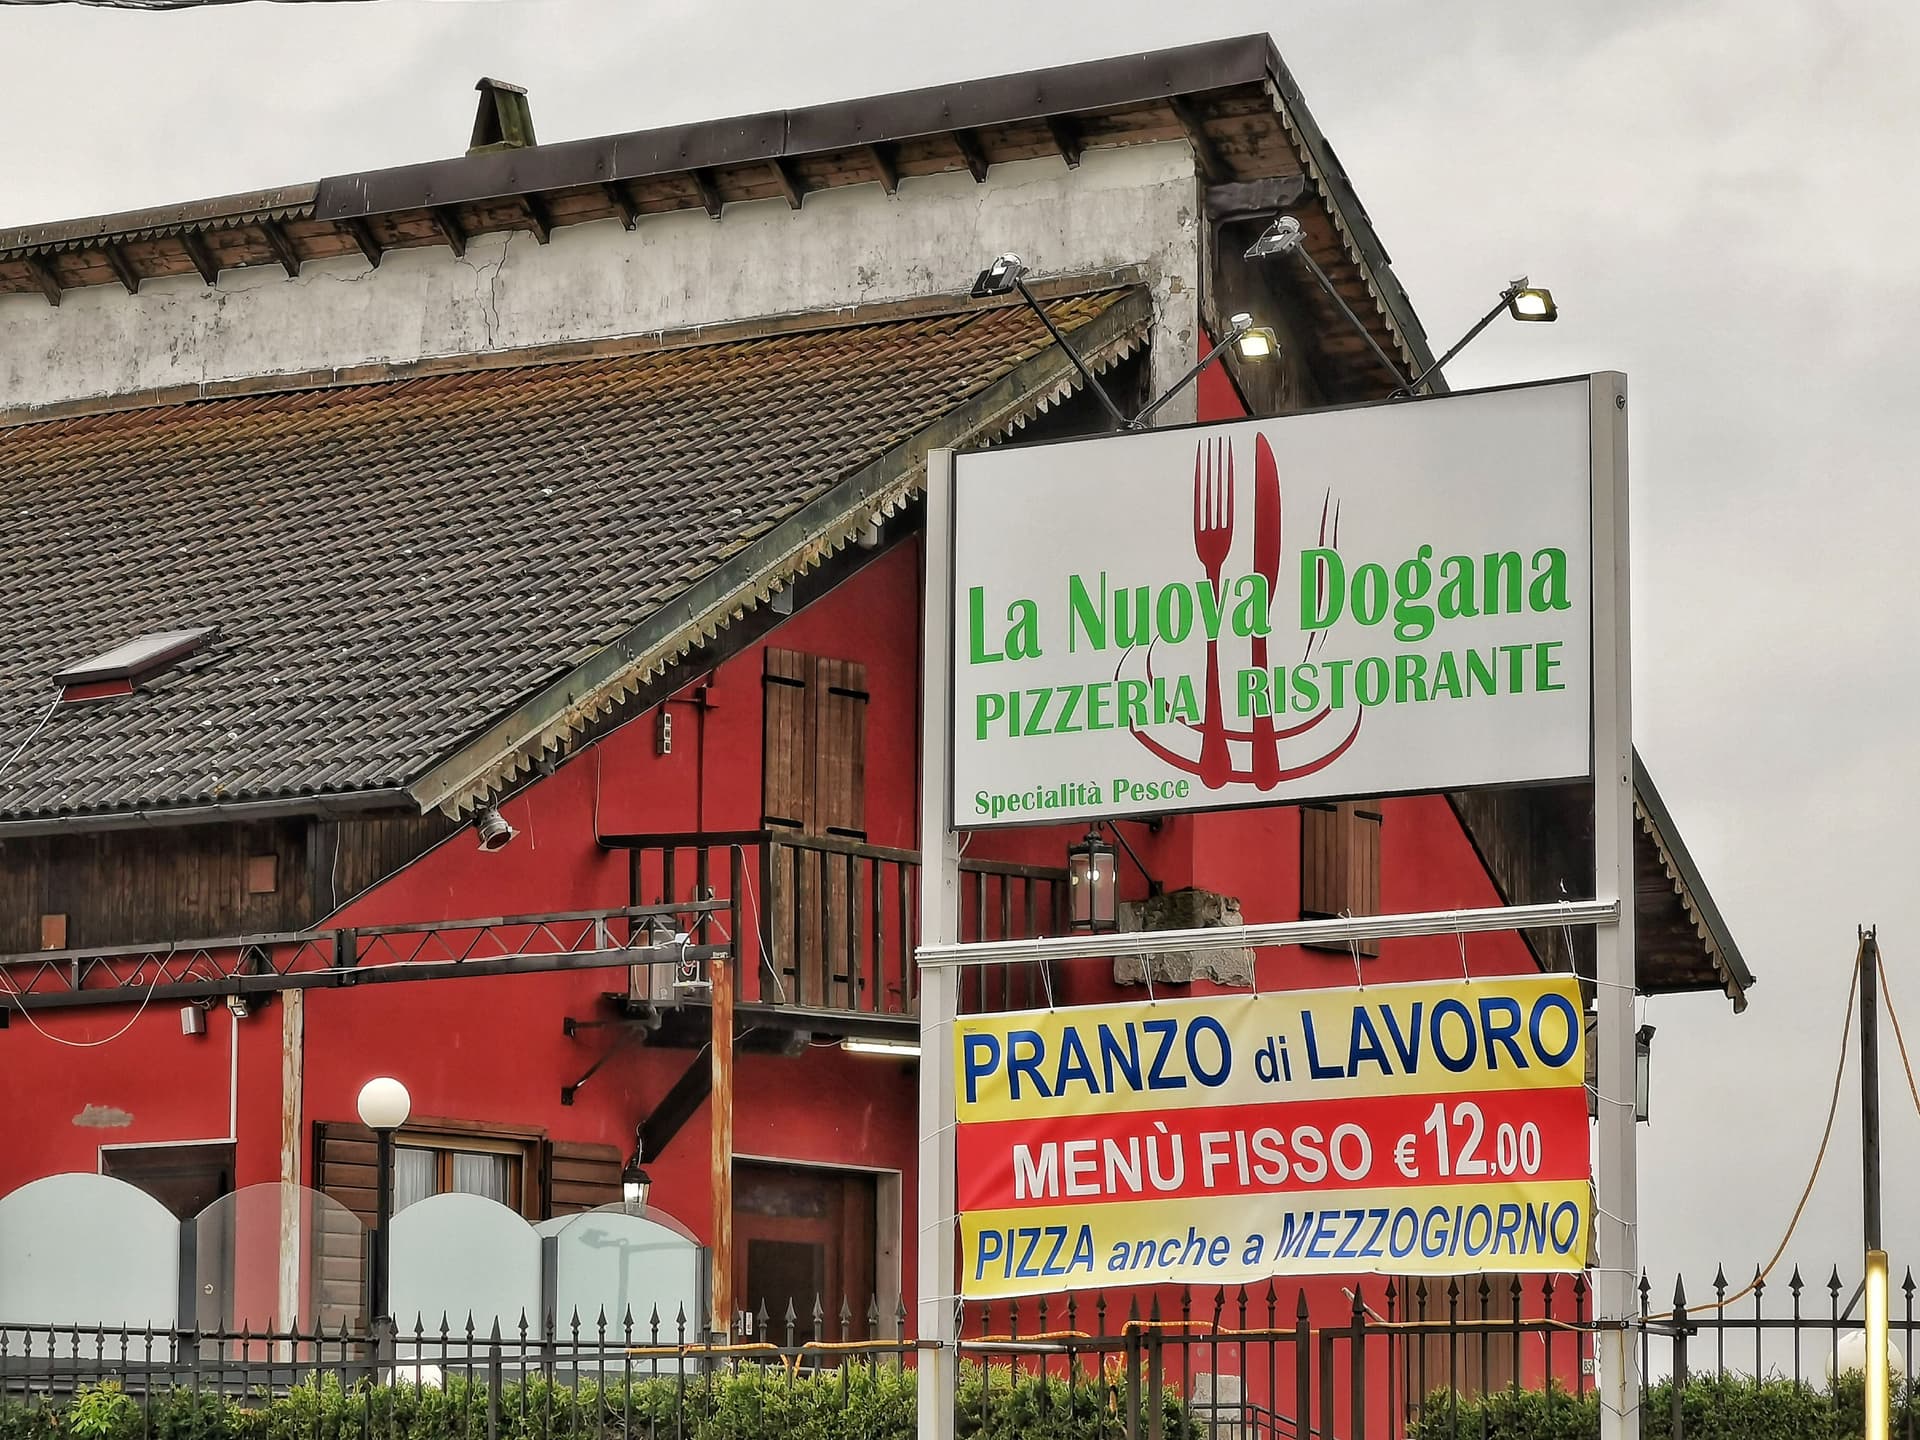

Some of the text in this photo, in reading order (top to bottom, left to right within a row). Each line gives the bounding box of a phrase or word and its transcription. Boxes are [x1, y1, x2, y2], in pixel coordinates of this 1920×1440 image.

[967, 543, 1573, 665] La Nuova Dogana
[975, 640, 1567, 741] PIZZERIA RISTORANTE
[974, 776, 1190, 818] Specialità Pesce
[963, 993, 1580, 1104] PRANZO di LAVORO
[1013, 1121, 1185, 1200] MENÙ
[1199, 1123, 1373, 1188] FISSO
[975, 1200, 1580, 1281] PIZZA anche a MEZZOGIORNO
